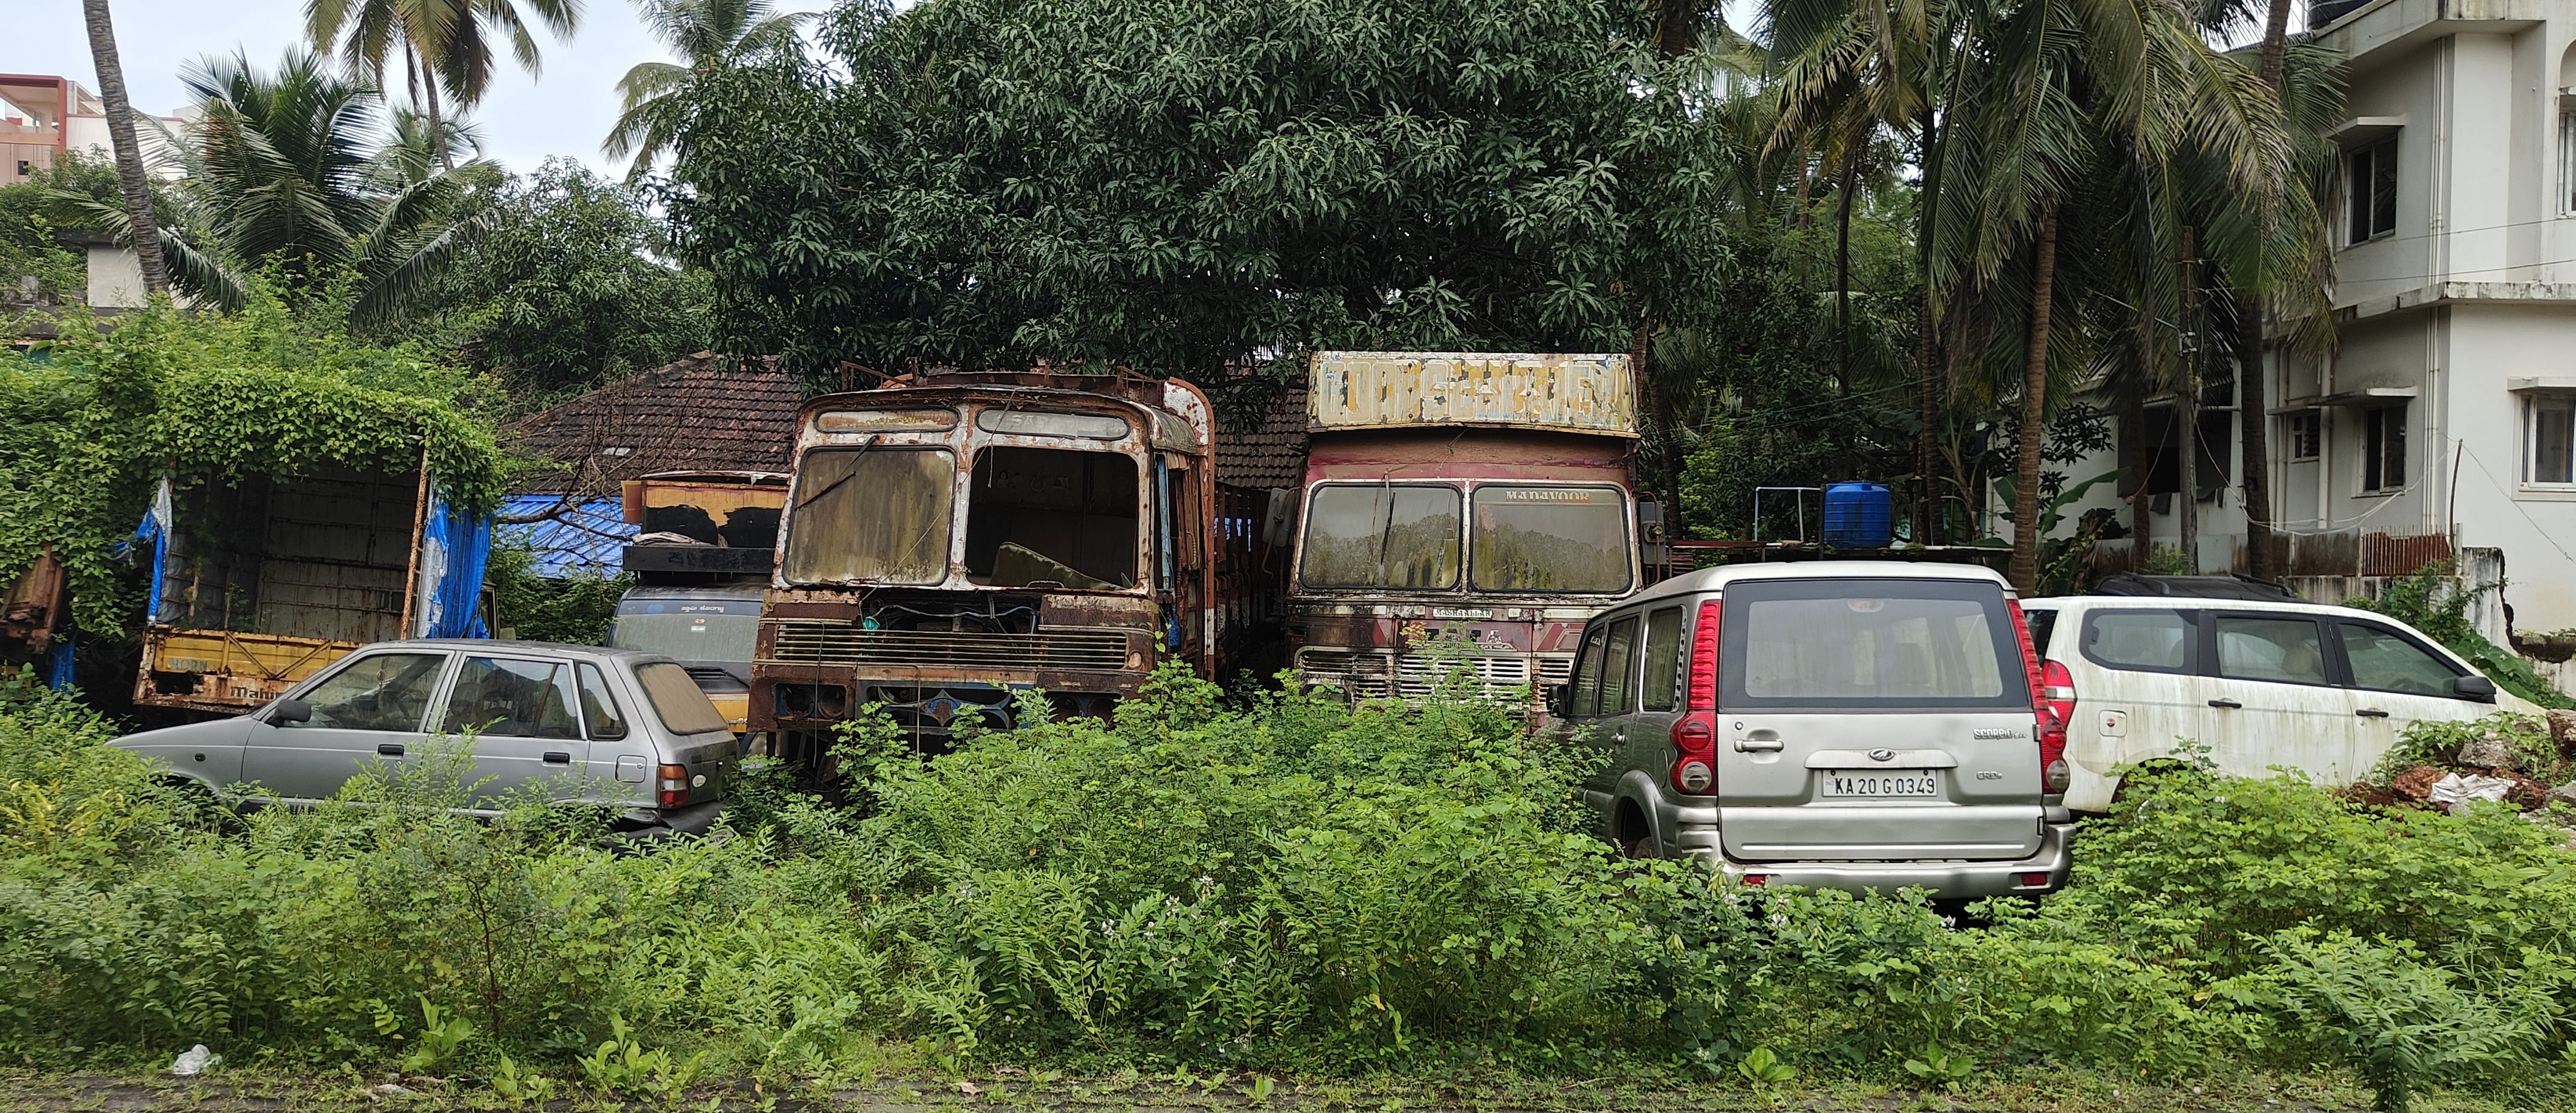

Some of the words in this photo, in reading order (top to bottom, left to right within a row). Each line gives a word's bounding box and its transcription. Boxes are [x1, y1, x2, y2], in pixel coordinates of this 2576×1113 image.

[1505, 490, 1591, 503] MADAVOOR
[1973, 728, 2013, 740] SCORPIO
[1835, 778, 1854, 794] KA
[1858, 778, 1877, 794] 20
[1883, 778, 1892, 794] G
[1895, 778, 1935, 794] 0349
